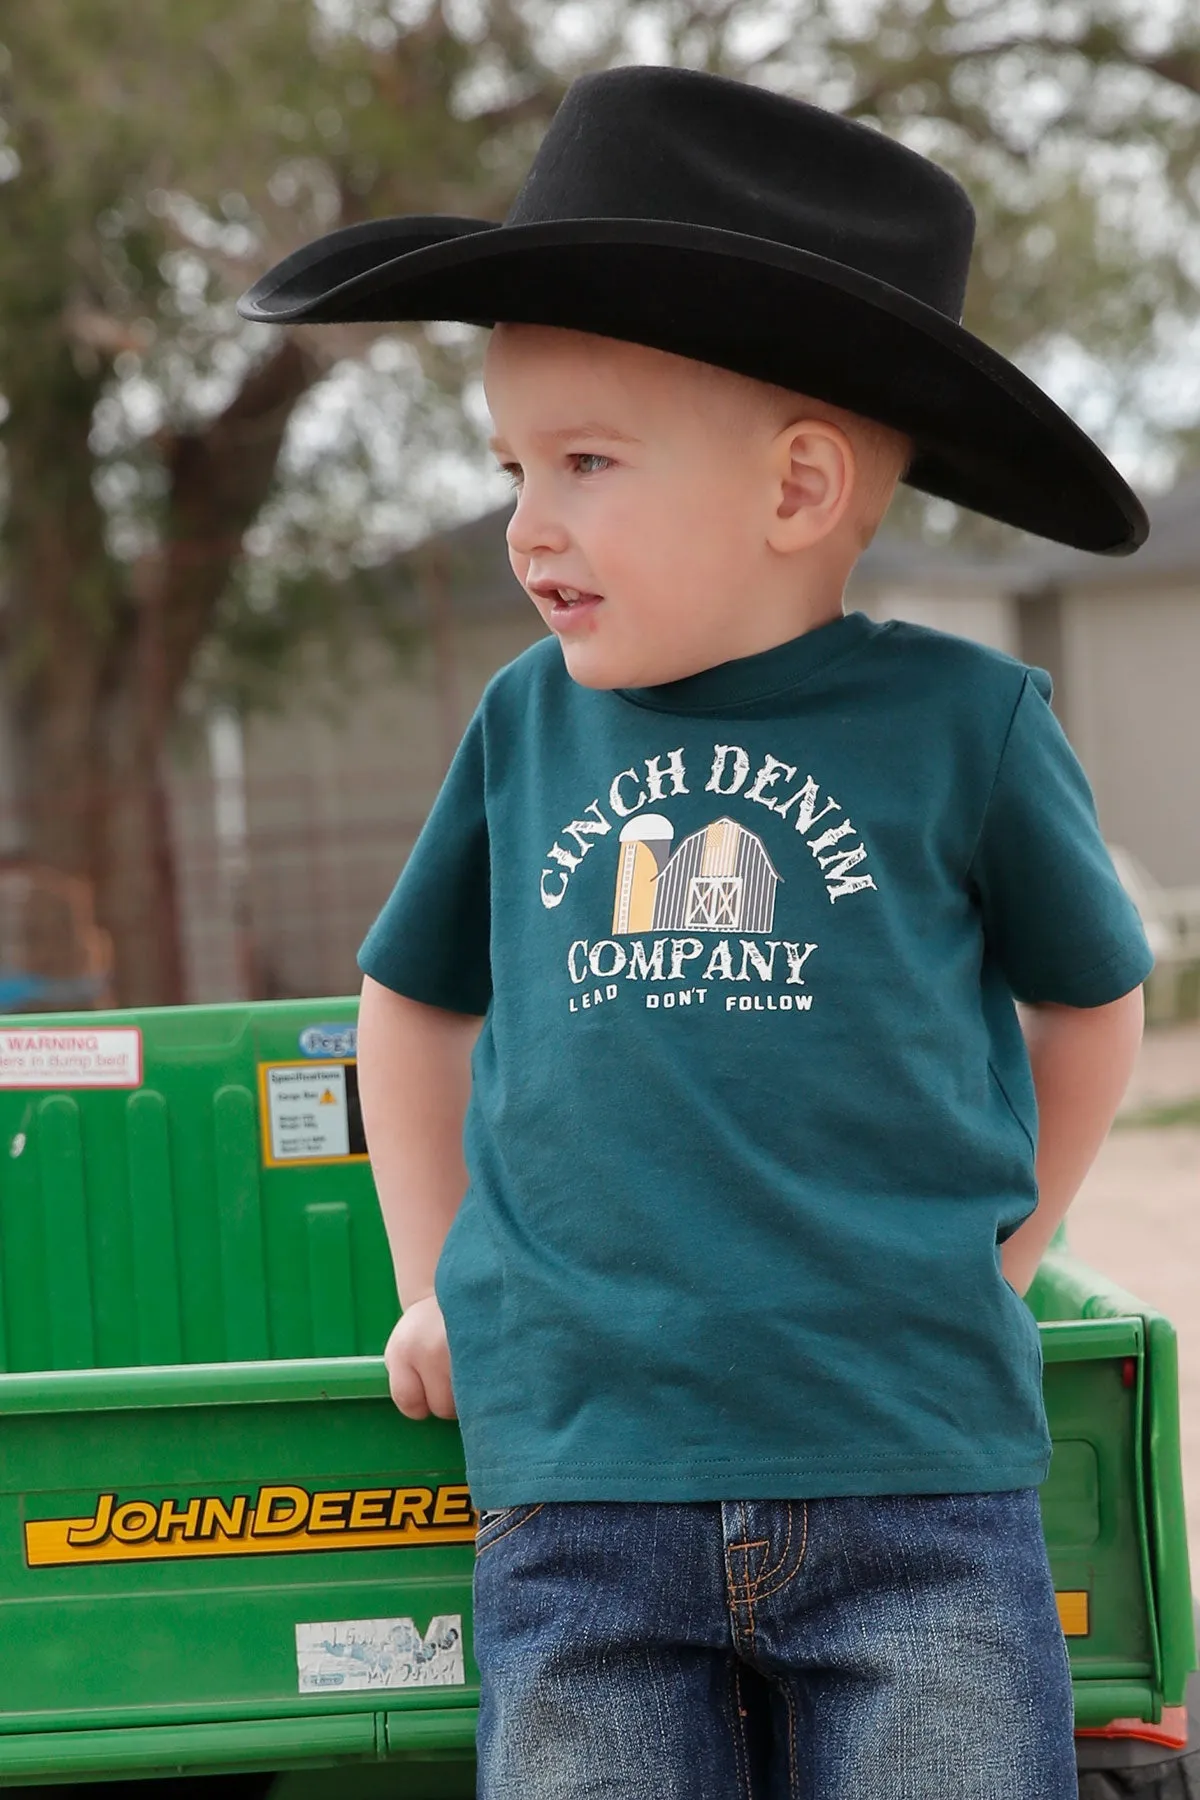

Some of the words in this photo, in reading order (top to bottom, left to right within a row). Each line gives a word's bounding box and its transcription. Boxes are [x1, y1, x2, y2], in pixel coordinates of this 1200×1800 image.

[540, 747, 689, 909] CINCH
[705, 744, 878, 904] DENIM
[568, 938, 818, 985] COMPANY
[569, 984, 617, 1012] LEAD
[646, 987, 708, 1009] DON'T
[726, 994, 813, 1010] FOLLOW
[7, 1036, 98, 1050] WARNING
[67, 1492, 247, 1548] JOHN
[250, 1484, 475, 1538] DEERE
